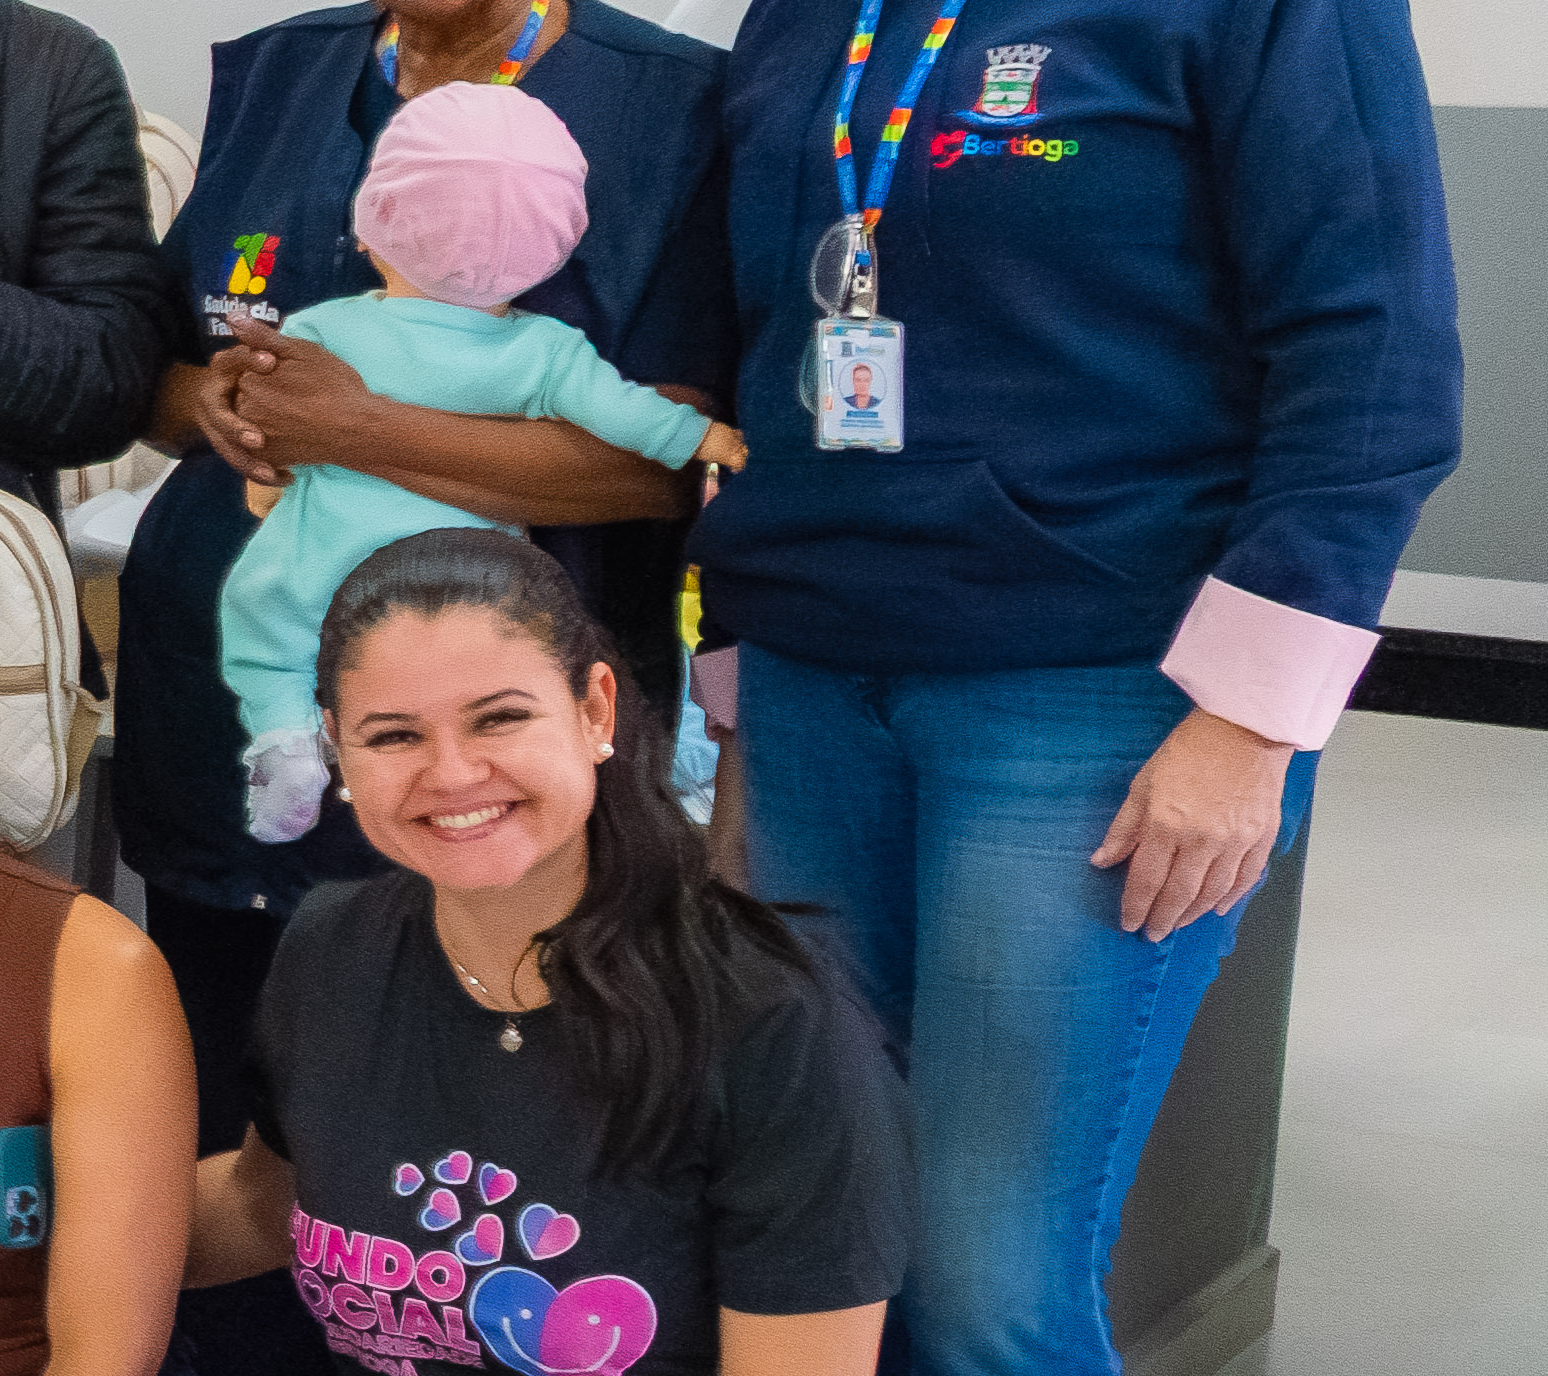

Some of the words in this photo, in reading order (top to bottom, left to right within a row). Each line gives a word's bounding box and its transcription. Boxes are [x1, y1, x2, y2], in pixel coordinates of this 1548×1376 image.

[962, 132, 1080, 163] Bertioga
[291, 1200, 466, 1303] UNDO
[297, 1268, 482, 1357] OCIAL
